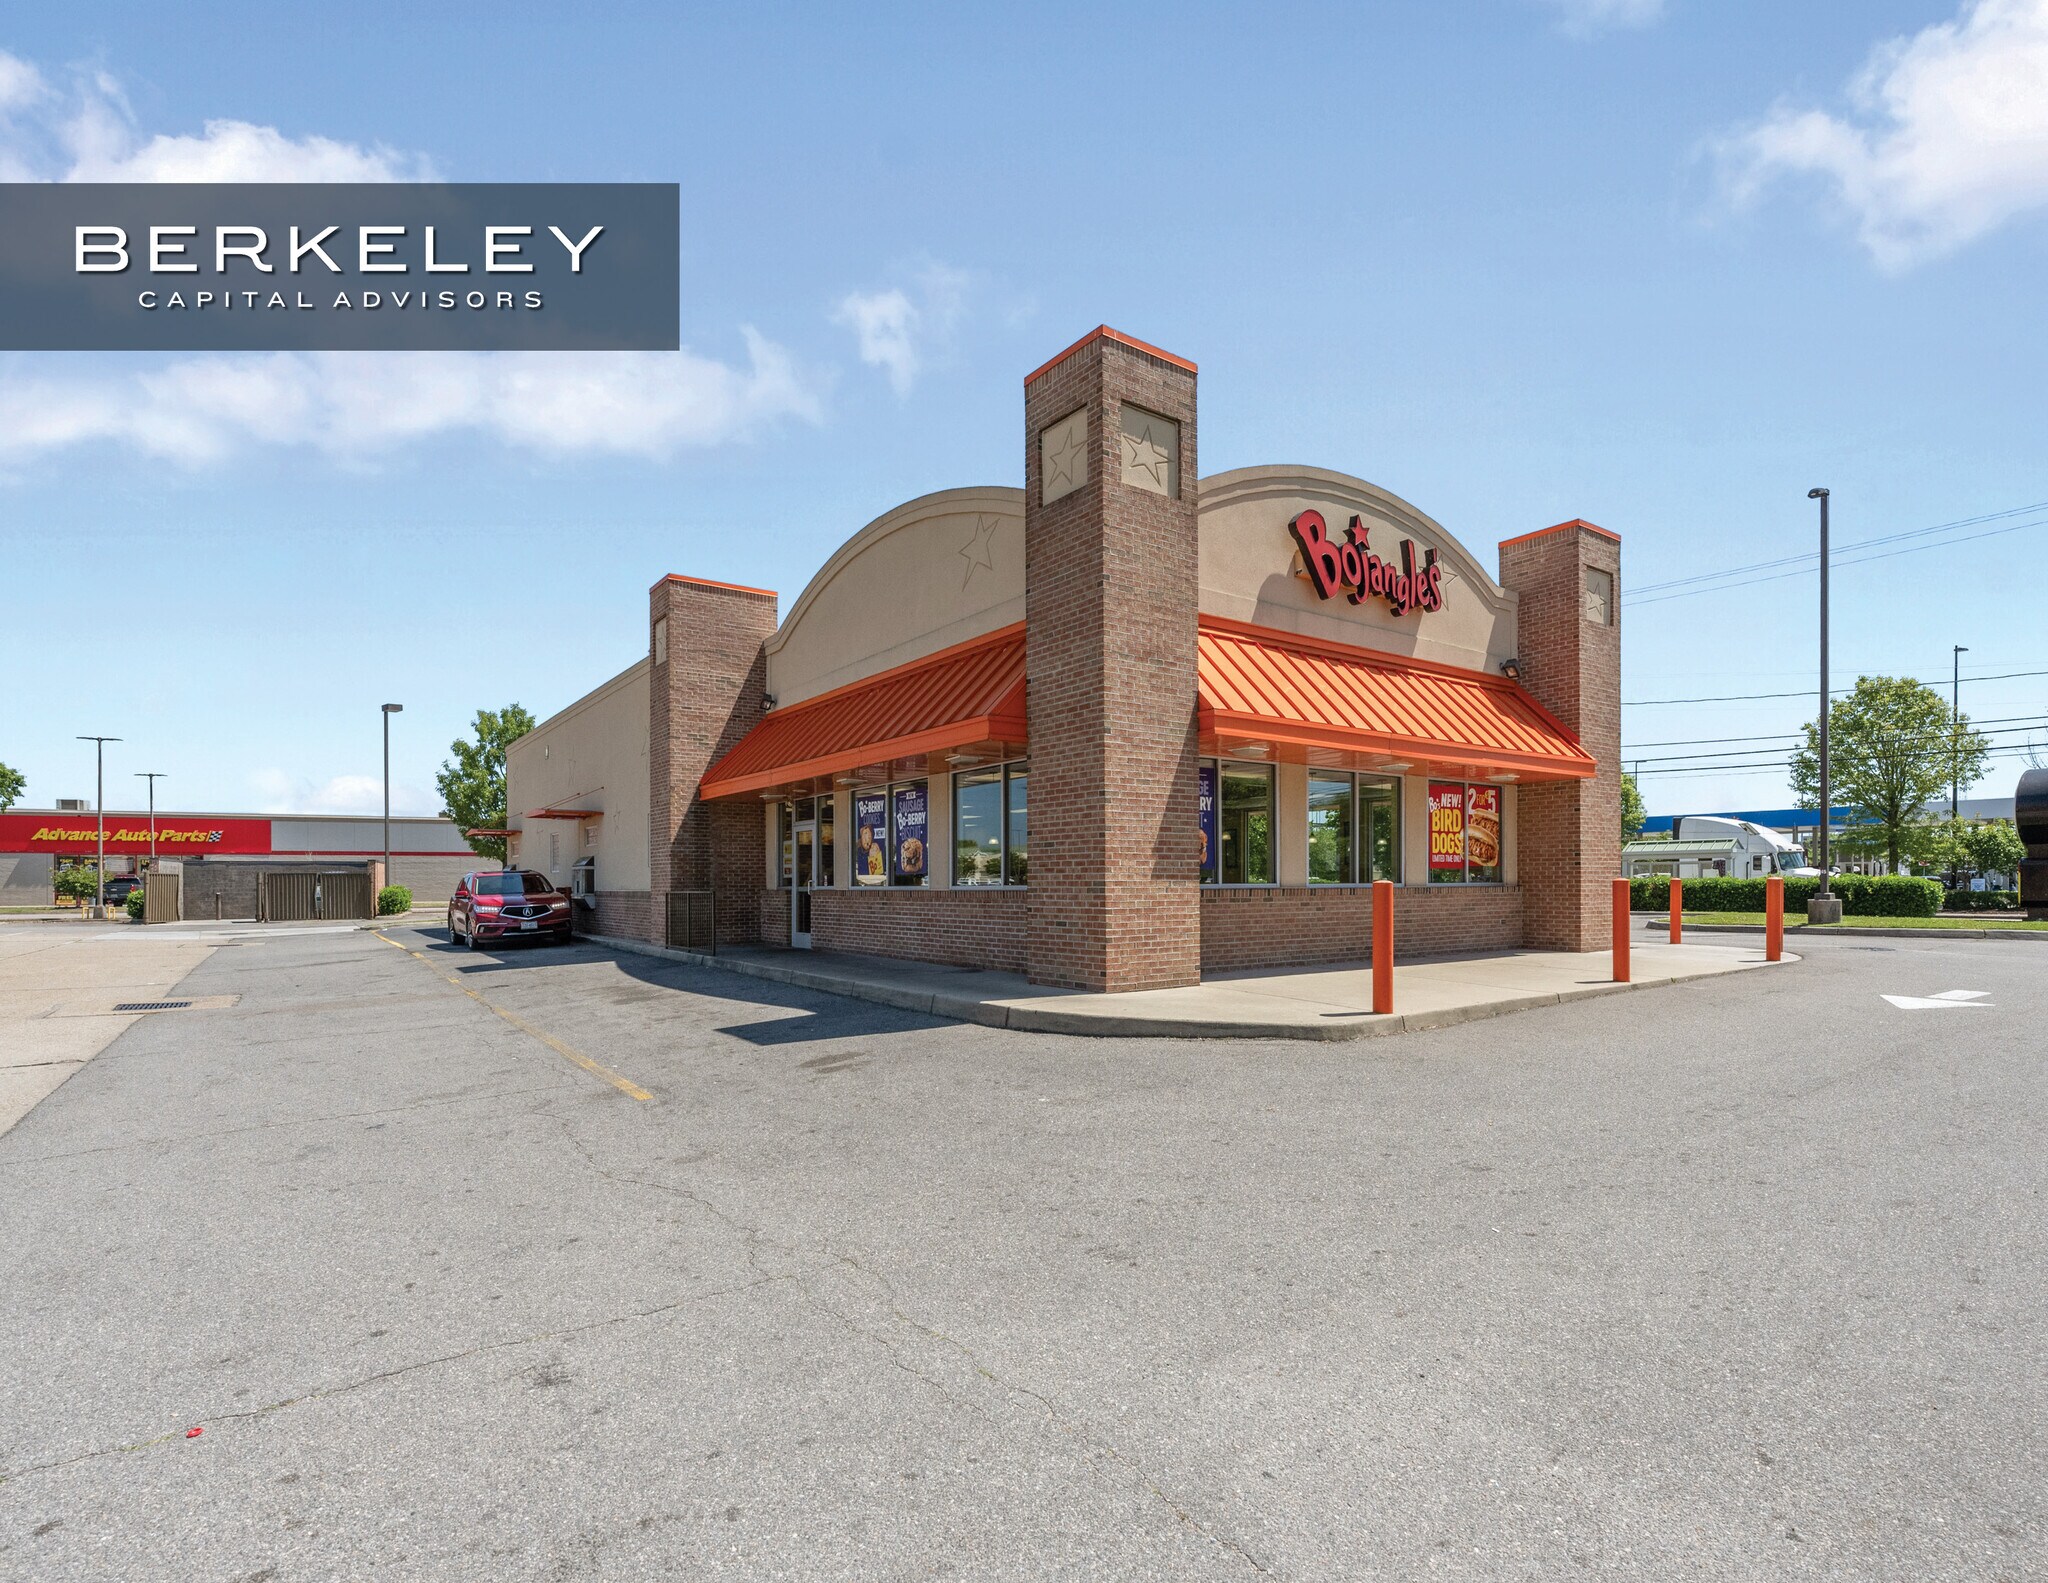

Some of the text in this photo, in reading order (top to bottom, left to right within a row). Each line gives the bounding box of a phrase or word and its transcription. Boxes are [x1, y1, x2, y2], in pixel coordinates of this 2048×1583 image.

[899, 799, 923, 812] SAUSAGE
[1441, 794, 1461, 807] NEW!
[1469, 788, 1477, 814] 2
[1477, 794, 1485, 805] FOR
[1432, 809, 1461, 832] BIRD
[32, 828, 207, 842] Advance Auto Parts
[901, 826, 921, 840] BISCUIT
[1432, 833, 1461, 853] DOGS
